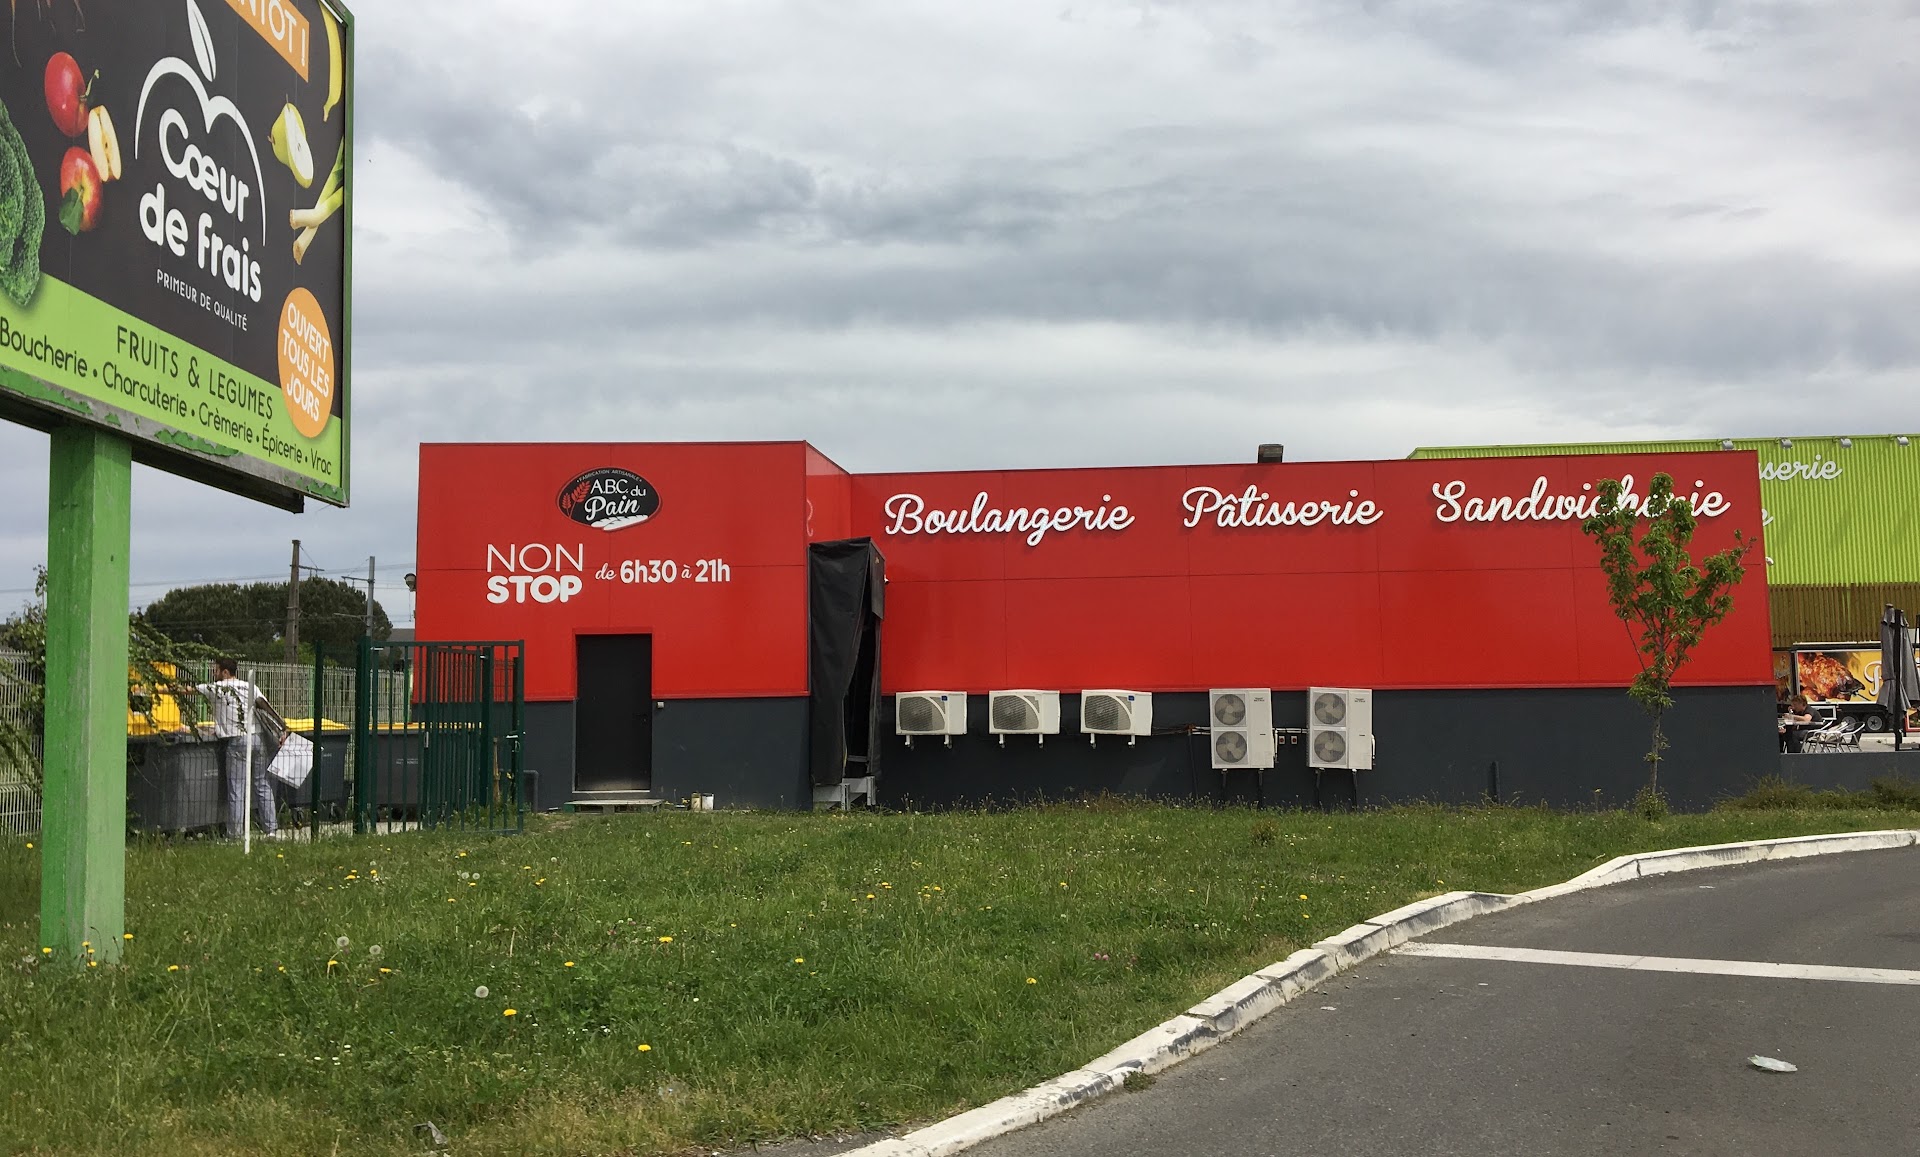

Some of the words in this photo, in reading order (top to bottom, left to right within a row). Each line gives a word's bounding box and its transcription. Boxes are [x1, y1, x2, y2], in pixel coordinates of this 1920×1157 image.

[158, 108, 250, 222] Cœur
[139, 183, 189, 257] de
[197, 212, 263, 303] frais
[156, 268, 198, 303] PRIMEUR
[200, 292, 211, 311] DE
[213, 300, 248, 332] QUALITÉ
[287, 302, 329, 363] OUVERT
[117, 324, 179, 379] FRUITS
[188, 356, 200, 389] &
[209, 368, 273, 420] LEGUMES
[283, 328, 309, 378] TOUS
[310, 359, 330, 398] LES
[0, 316, 88, 378] Boucherie
[102, 361, 188, 417] Charcuterie
[199, 401, 253, 443] Crèmerie
[261, 423, 303, 464] Épicerie
[310, 448, 332, 475] Vrac
[286, 373, 320, 422] JOURS
[579, 469, 610, 482] FABRICATION
[611, 469, 639, 482] ARTISANALE
[630, 485, 646, 497] du
[1758, 454, 1843, 481] serie
[584, 495, 640, 521] Pain
[884, 491, 1135, 547] Boulangerie
[1182, 484, 1384, 529] Pâtisserie
[486, 543, 584, 573] NON
[595, 562, 617, 581] de
[619, 559, 677, 583] 6h30
[681, 564, 692, 580] à
[694, 558, 731, 583] 21h
[486, 574, 583, 604] STOP
